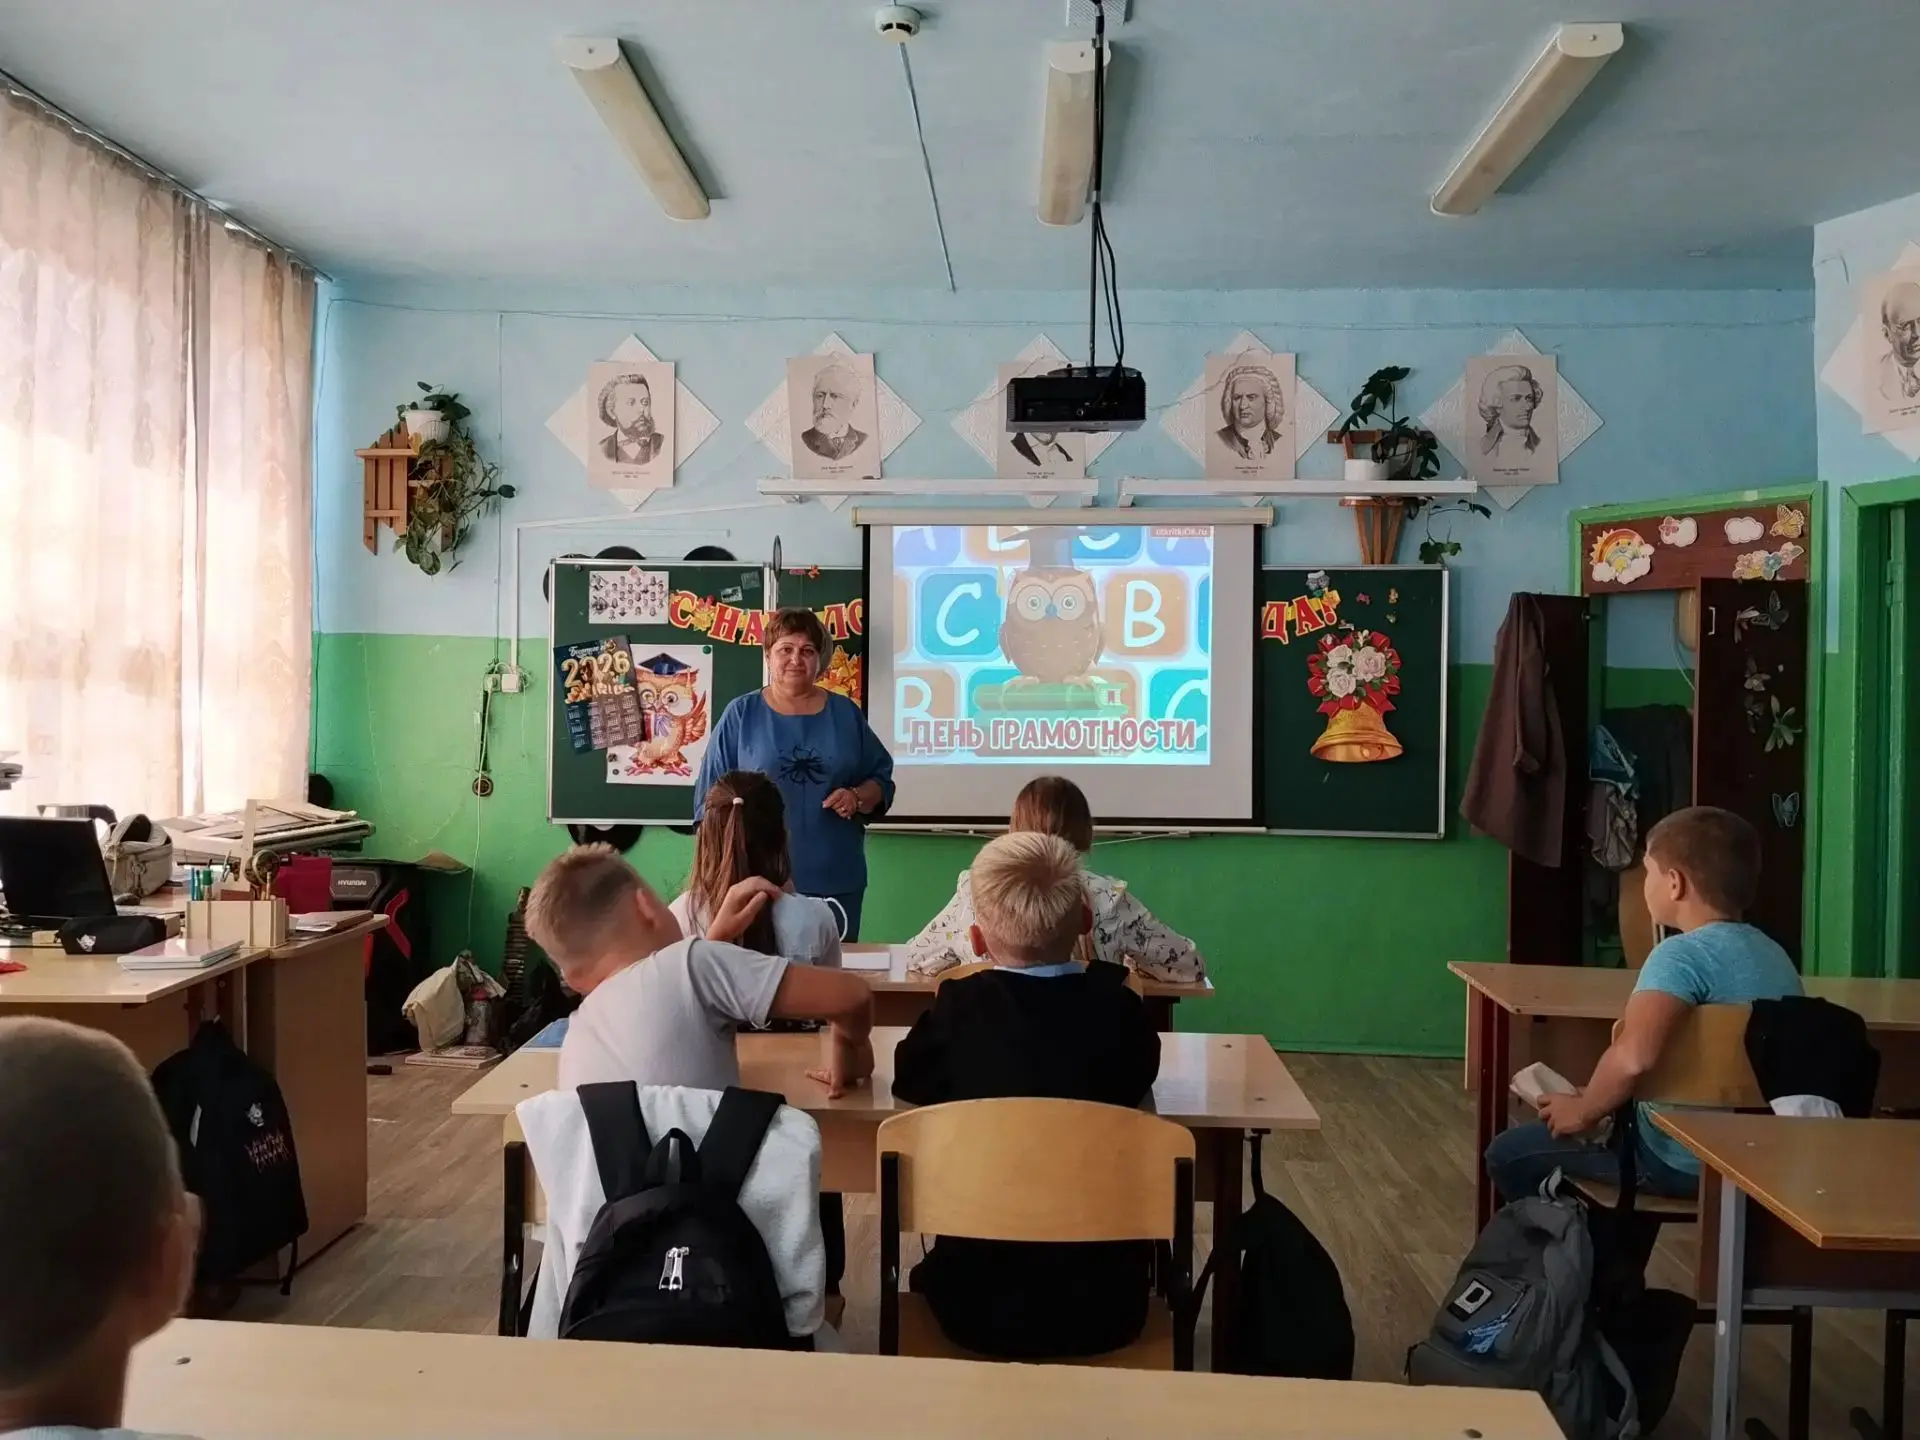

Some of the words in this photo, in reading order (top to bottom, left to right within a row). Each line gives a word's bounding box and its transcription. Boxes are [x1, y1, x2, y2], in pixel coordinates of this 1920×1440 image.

[669, 590, 697, 628] С
[561, 651, 630, 688] 2026
[909, 718, 984, 754] ДЕНЬ
[990, 717, 1196, 750] ГРАМОТНОСТИ
